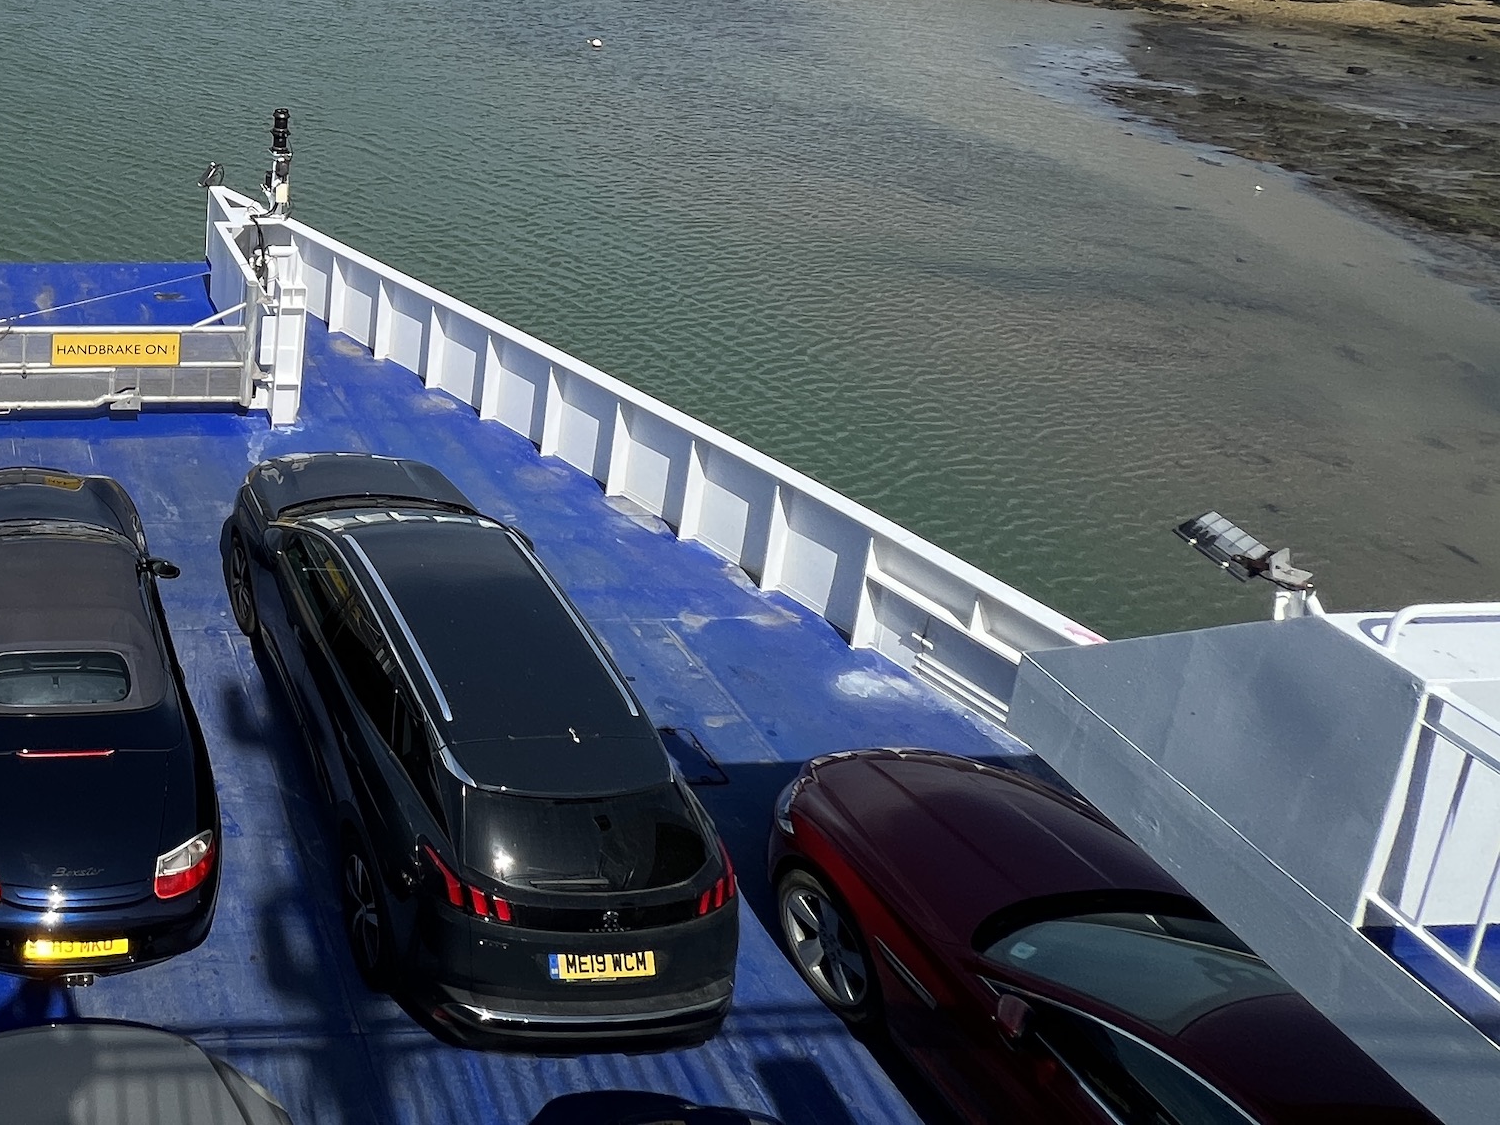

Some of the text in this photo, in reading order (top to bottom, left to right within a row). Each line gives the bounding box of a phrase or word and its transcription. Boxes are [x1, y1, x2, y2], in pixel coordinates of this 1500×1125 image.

[56, 344, 141, 355] HANDBRAKE
[145, 344, 168, 355] ON
[566, 952, 647, 973] ME19 WCM
